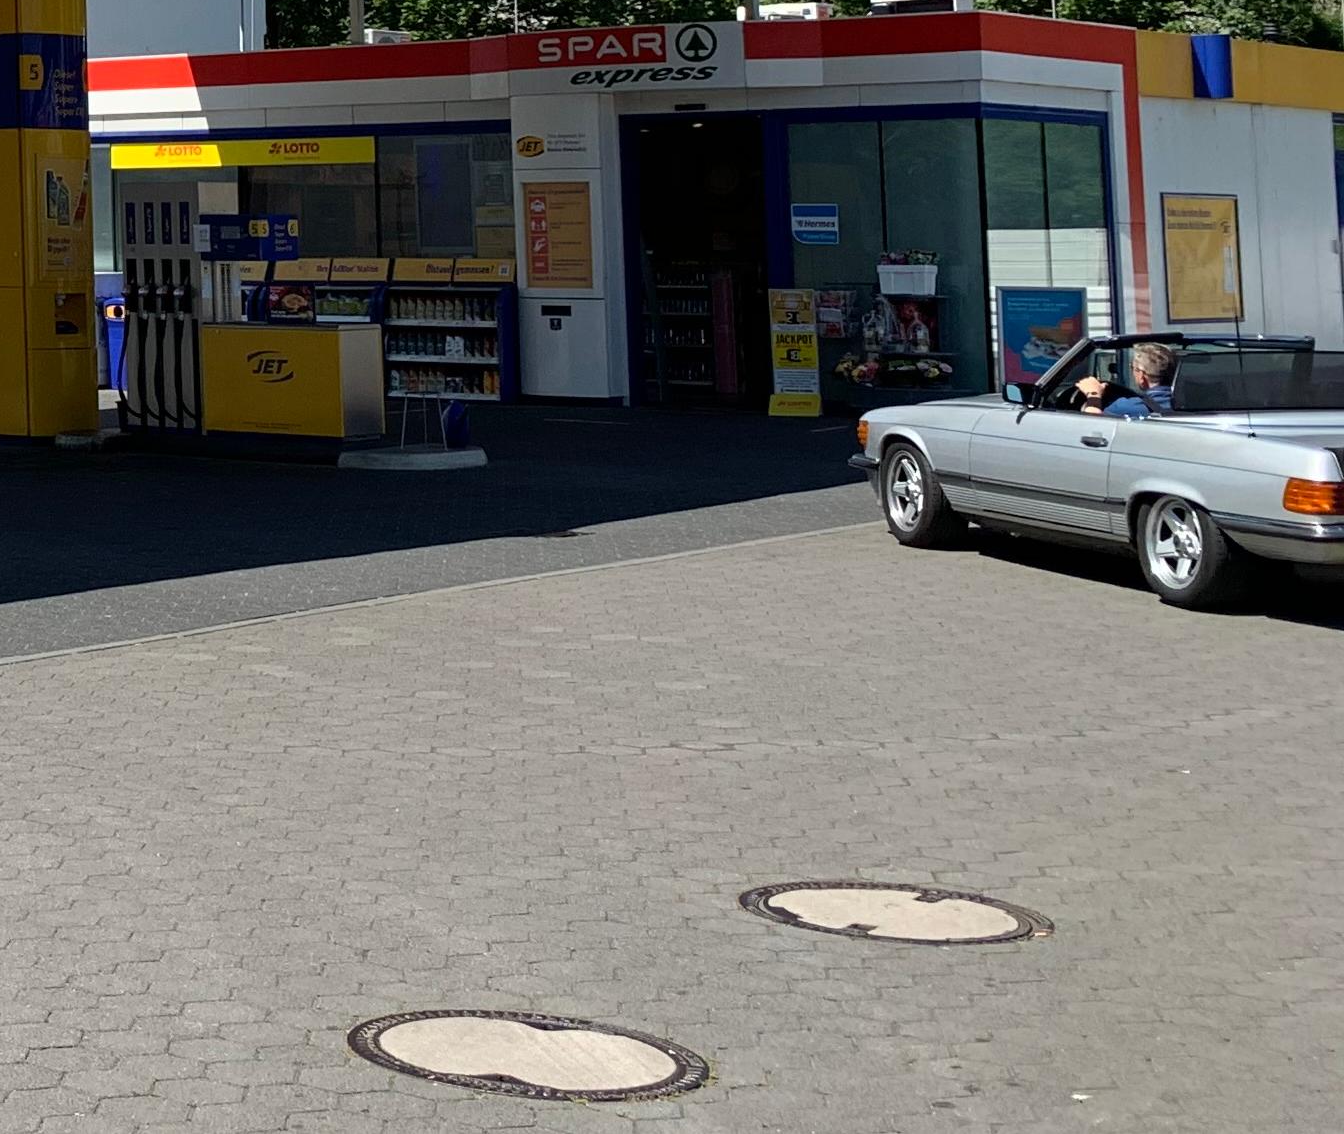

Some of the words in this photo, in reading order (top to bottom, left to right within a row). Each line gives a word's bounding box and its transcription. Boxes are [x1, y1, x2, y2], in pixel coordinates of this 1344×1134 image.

[537, 32, 664, 63] SPAR
[30, 64, 39, 80] 5
[570, 66, 718, 88] express
[169, 146, 202, 155] LOTTO
[284, 143, 320, 154] LOTTO
[519, 141, 542, 152] JET
[776, 334, 813, 345] JACKPOT
[252, 359, 288, 374] JET
